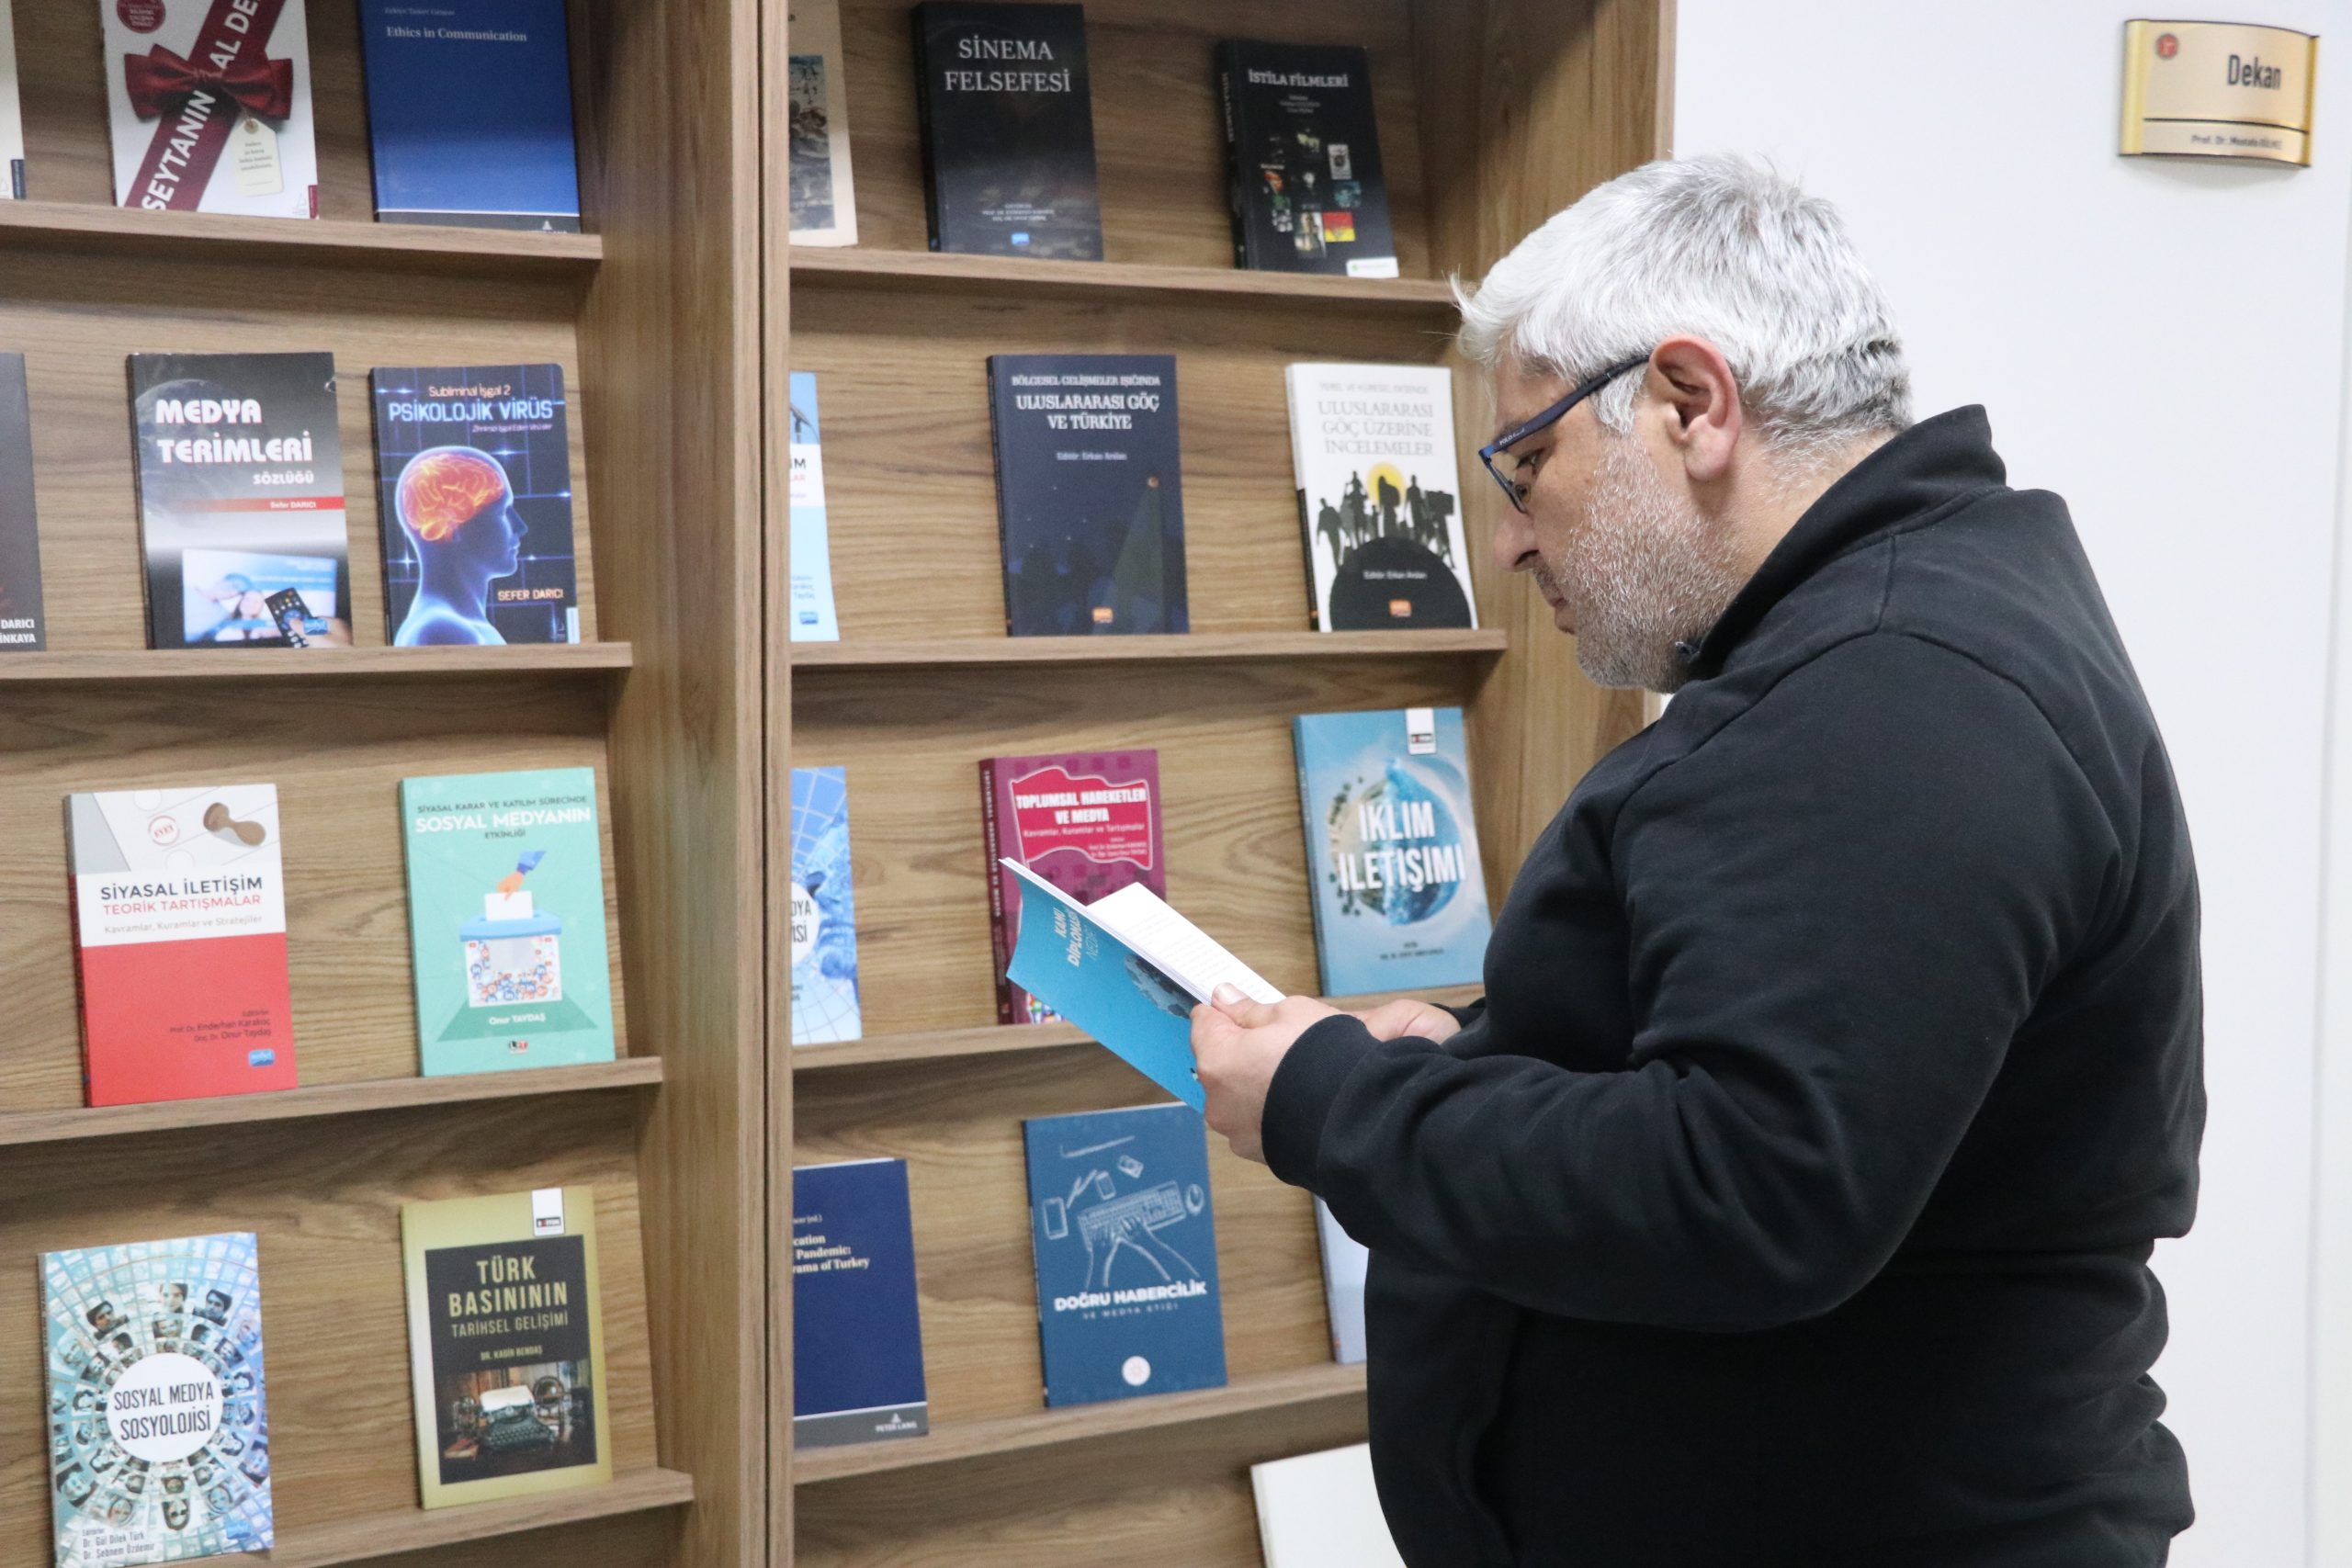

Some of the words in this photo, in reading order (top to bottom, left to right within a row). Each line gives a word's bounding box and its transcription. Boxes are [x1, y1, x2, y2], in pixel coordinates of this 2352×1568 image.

[224, 0, 262, 34] DE
[386, 26, 422, 39] Ethics
[424, 27, 435, 39] in
[437, 28, 527, 42] Communication
[958, 34, 1055, 61] SİNEMA
[944, 68, 1072, 93] FELSEFESİ
[1248, 68, 1288, 85] İSTİLA
[1289, 72, 1350, 87] FİLMLERİ
[2227, 53, 2282, 90] Dekan
[428, 384, 478, 398] Subliminal
[503, 384, 513, 397] 2
[1015, 394, 1125, 411] ULUSLARARASI
[1126, 391, 1160, 412] GÖÇ
[155, 398, 264, 424] MEDYA
[388, 398, 493, 423] PSİKOLOJİK
[498, 396, 554, 421] VİRÜS
[1317, 400, 1434, 418] ULUSLARARASI
[1046, 414, 1069, 430] VE
[1069, 412, 1133, 430] TÜRKİYE
[1322, 416, 1360, 438] GÖÇ
[1363, 418, 1433, 437] ÜZERİNE
[156, 430, 314, 464] TERİMLERİ
[1324, 437, 1433, 457] İNCELEMELER
[252, 469, 315, 486] SÖZLÜĞÜ
[497, 589, 530, 602] SEFER
[532, 587, 565, 600] DARICI
[1, 617, 36, 630] DARICI
[416, 802, 453, 814] SİYASAL
[455, 801, 486, 812] KARAR
[488, 801, 500, 809] VE
[503, 798, 537, 808] KATILIM
[538, 795, 588, 807] SÜRECİNDE
[1015, 791, 1080, 809] TOPLUMSAL
[1080, 787, 1148, 806] HAREKETLER
[414, 812, 488, 834] SOSYAL
[492, 807, 592, 829] MEDYANIN
[1054, 809, 1070, 825] VE
[1070, 807, 1110, 824] MEDYA
[154, 824, 175, 839] EVET
[484, 829, 526, 840] ETKİNLİĞİ
[100, 882, 179, 901] SİYASAL
[183, 874, 264, 896] İLETİŞİM
[103, 901, 157, 916] TEORİK
[161, 895, 262, 911] TARTIŞMALAR
[104, 923, 156, 935] Kavramlar,
[156, 919, 200, 931] Kuramlar
[215, 915, 264, 927] Stratejiler
[793, 1234, 827, 1247] cation
[796, 1244, 852, 1260] Pandemic:
[475, 1253, 537, 1285] TÜRK
[820, 1258, 832, 1271] of
[832, 1256, 870, 1270] Turkey
[448, 1280, 568, 1318] BASINININ
[1054, 1291, 1112, 1312] DOĞRU
[1113, 1278, 1208, 1305] HABERCİLİK
[451, 1317, 511, 1338] TARİHSEL
[514, 1309, 569, 1332] GELİŞİMİ
[113, 1385, 166, 1412] SOSYAL
[168, 1381, 215, 1405] MEDYA
[119, 1404, 212, 1442] SOSYOLOJİSİ
